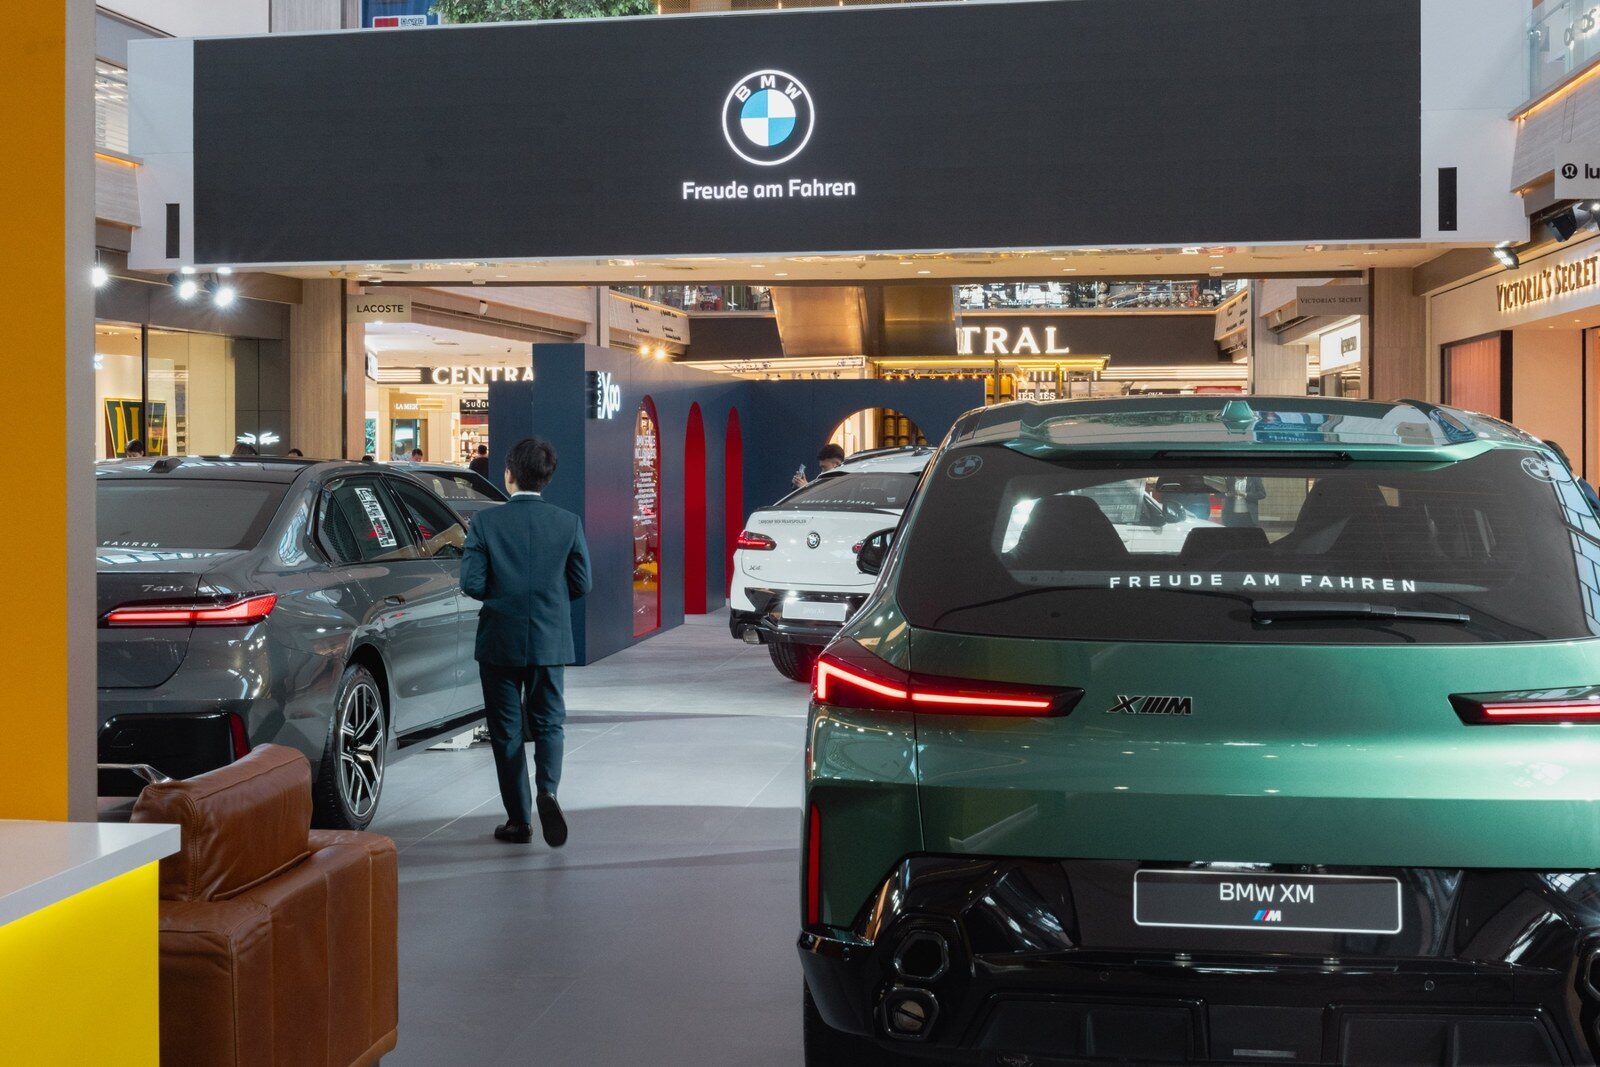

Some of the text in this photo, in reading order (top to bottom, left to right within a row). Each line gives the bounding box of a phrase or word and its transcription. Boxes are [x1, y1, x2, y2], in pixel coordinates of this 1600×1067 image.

[735, 75, 802, 102] BMW
[683, 179, 856, 199] Freude am Fahren
[1496, 256, 1598, 311] VICTORIA'S SECRET
[356, 304, 404, 313] LACOSTE
[103, 540, 159, 548] FAHREN
[1110, 573, 1416, 592] FREUDE AM FAHREN
[1220, 883, 1314, 903] BMW XM
